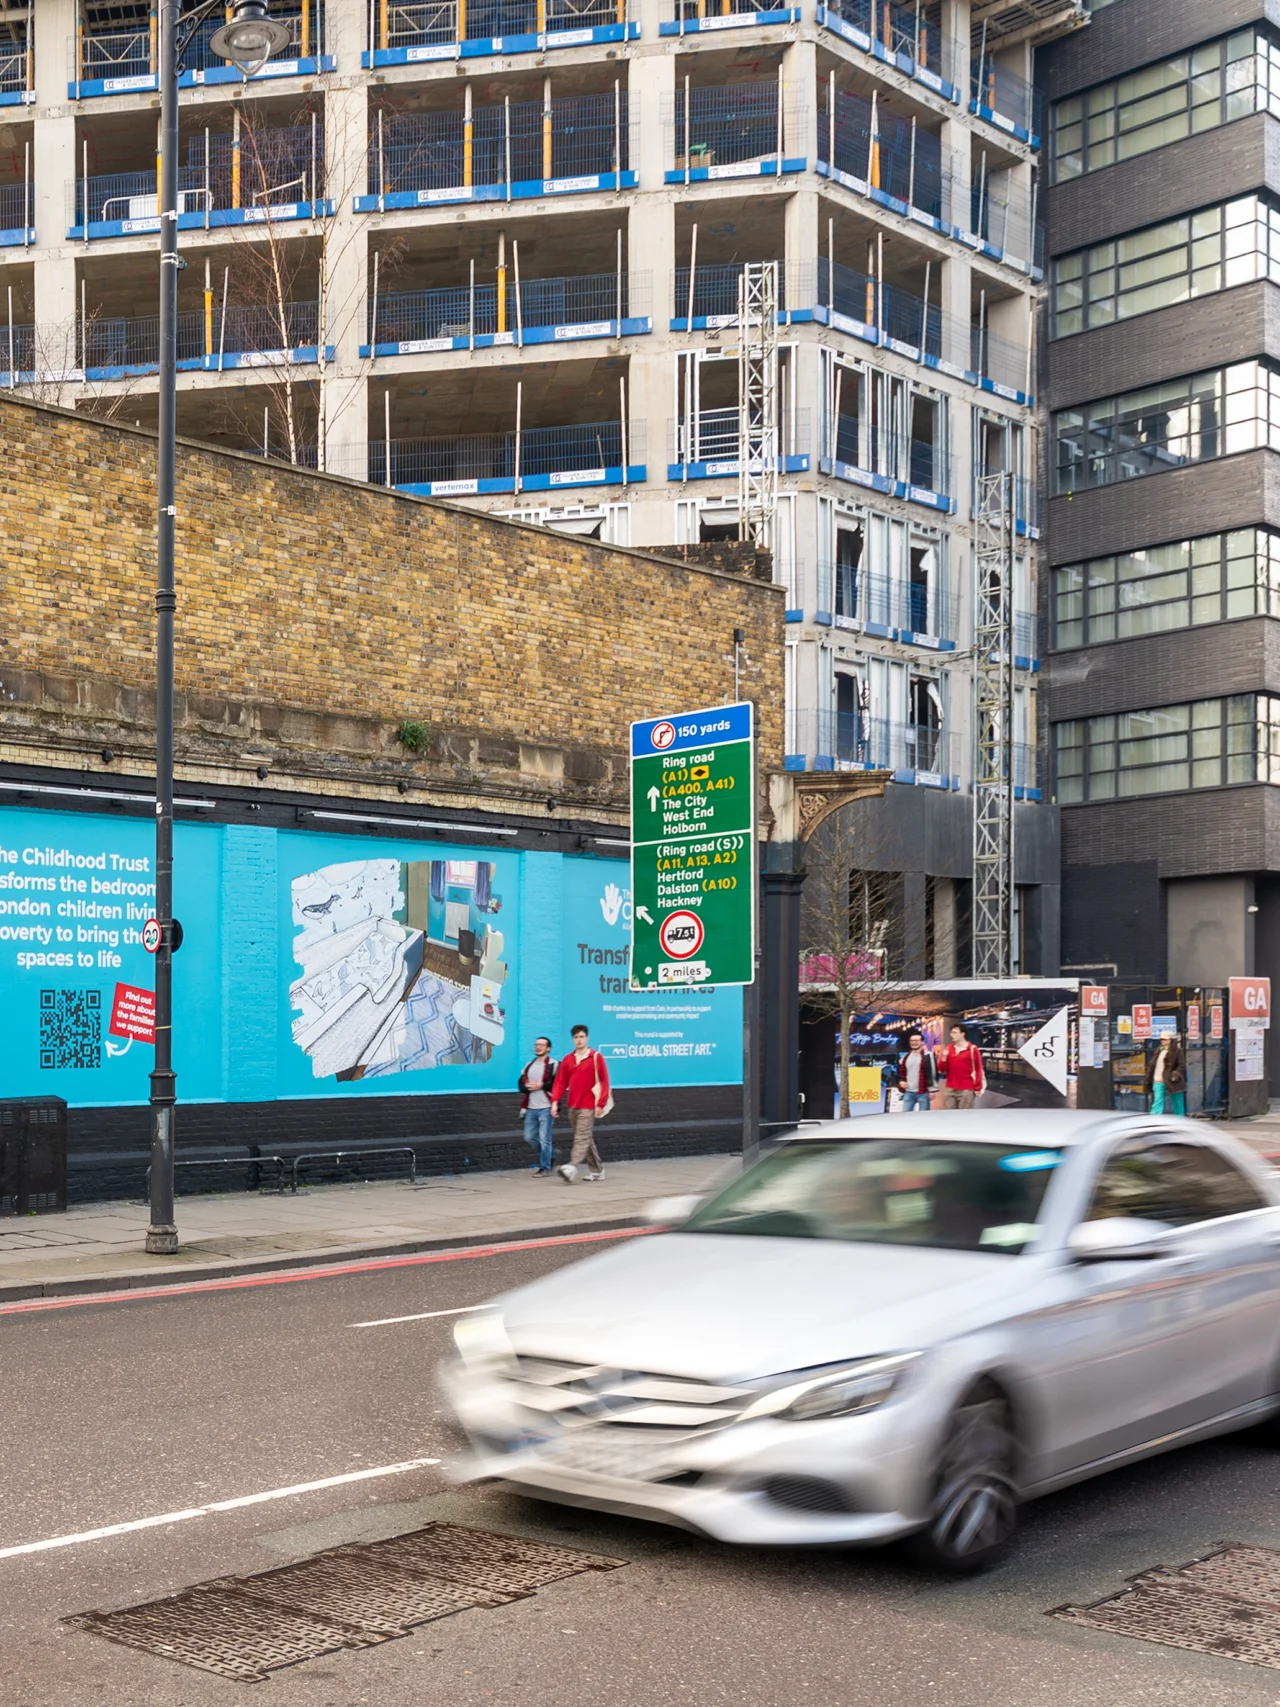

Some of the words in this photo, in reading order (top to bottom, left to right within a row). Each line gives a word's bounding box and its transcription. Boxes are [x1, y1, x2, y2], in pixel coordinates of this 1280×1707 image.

[678, 725, 697, 737] 150
[700, 720, 730, 736] yards
[663, 757, 686, 768] Ring
[689, 750, 715, 764] road
[662, 768, 688, 784] (A1)
[706, 776, 734, 791] A41)
[662, 799, 681, 809] The
[685, 796, 707, 807] City
[663, 810, 689, 822] West
[694, 805, 713, 818] End
[663, 822, 707, 835] Holborn
[657, 846, 686, 858] (Ring
[690, 841, 714, 853] road
[22, 848, 106, 869] Childhood
[110, 854, 149, 872] Trust
[714, 851, 736, 864] A2)
[657, 868, 703, 883] Hertford
[60, 875, 87, 892] the
[658, 883, 698, 895] Dalston
[702, 876, 737, 892] (A10)
[57, 900, 122, 919] children
[657, 896, 703, 908] Hackney
[56, 926, 73, 941] to
[77, 923, 120, 948] bring
[17, 952, 73, 969] spaces
[77, 952, 94, 967] to
[98, 951, 122, 967] life
[661, 967, 670, 978] 2
[672, 966, 702, 977] miles
[118, 1001, 136, 1011] more
[140, 997, 152, 1005] out
[1090, 991, 1106, 1006] GA
[1244, 986, 1267, 1011] GA
[117, 1010, 128, 1020] the
[116, 1021, 126, 1030] we
[127, 1024, 152, 1036] support
[628, 1045, 662, 1057] GLOBAL
[663, 1044, 694, 1056] STREET
[848, 1089, 879, 1101] savills
